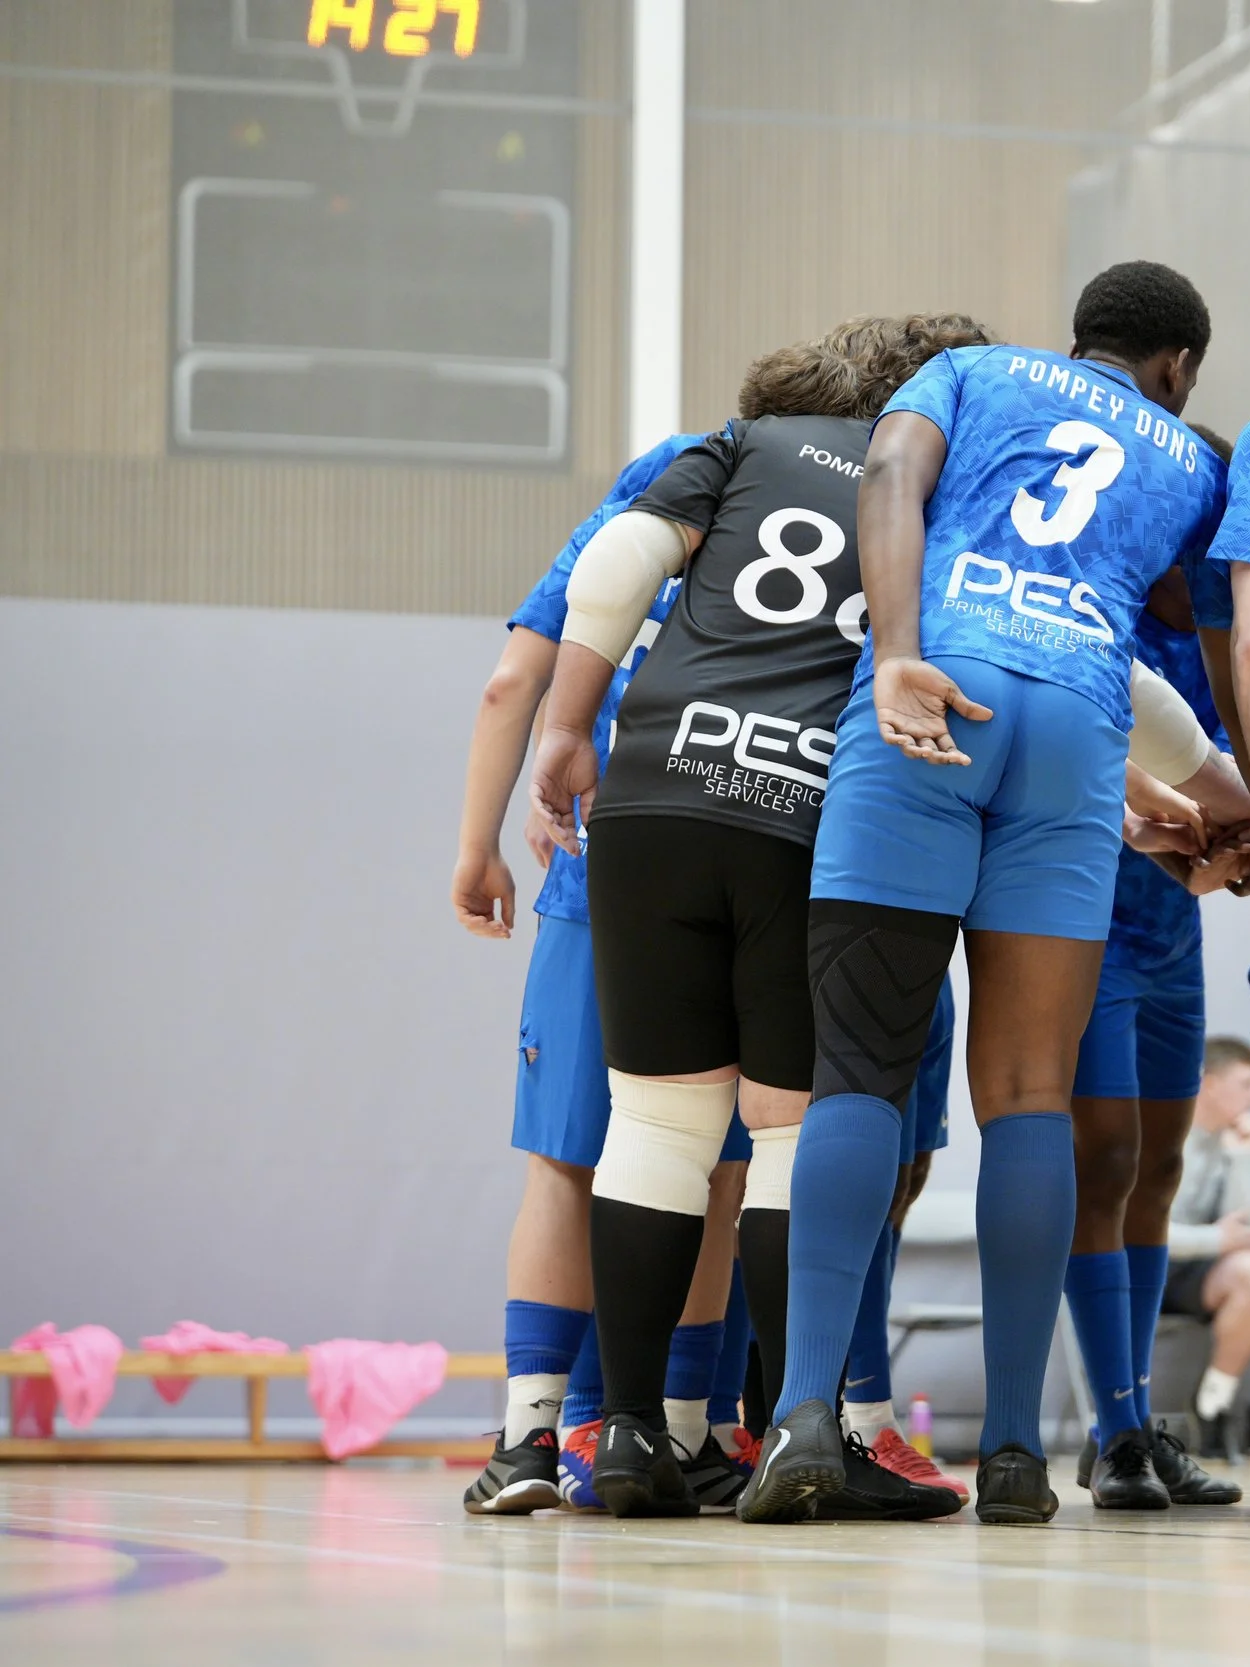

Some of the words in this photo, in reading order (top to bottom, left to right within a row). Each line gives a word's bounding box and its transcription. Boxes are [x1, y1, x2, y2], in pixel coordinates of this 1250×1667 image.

[1008, 355, 1125, 422] POMPEY
[1134, 407, 1199, 475] DONS
[1010, 420, 1125, 547] 3
[942, 599, 1005, 622] PRIME
[945, 551, 1114, 644] PES
[985, 618, 1077, 653] SERVICES
[666, 756, 727, 781] PRIME
[731, 768, 826, 808] ELECTRIC
[669, 701, 838, 792] PES
[703, 779, 797, 814] SERVICES
